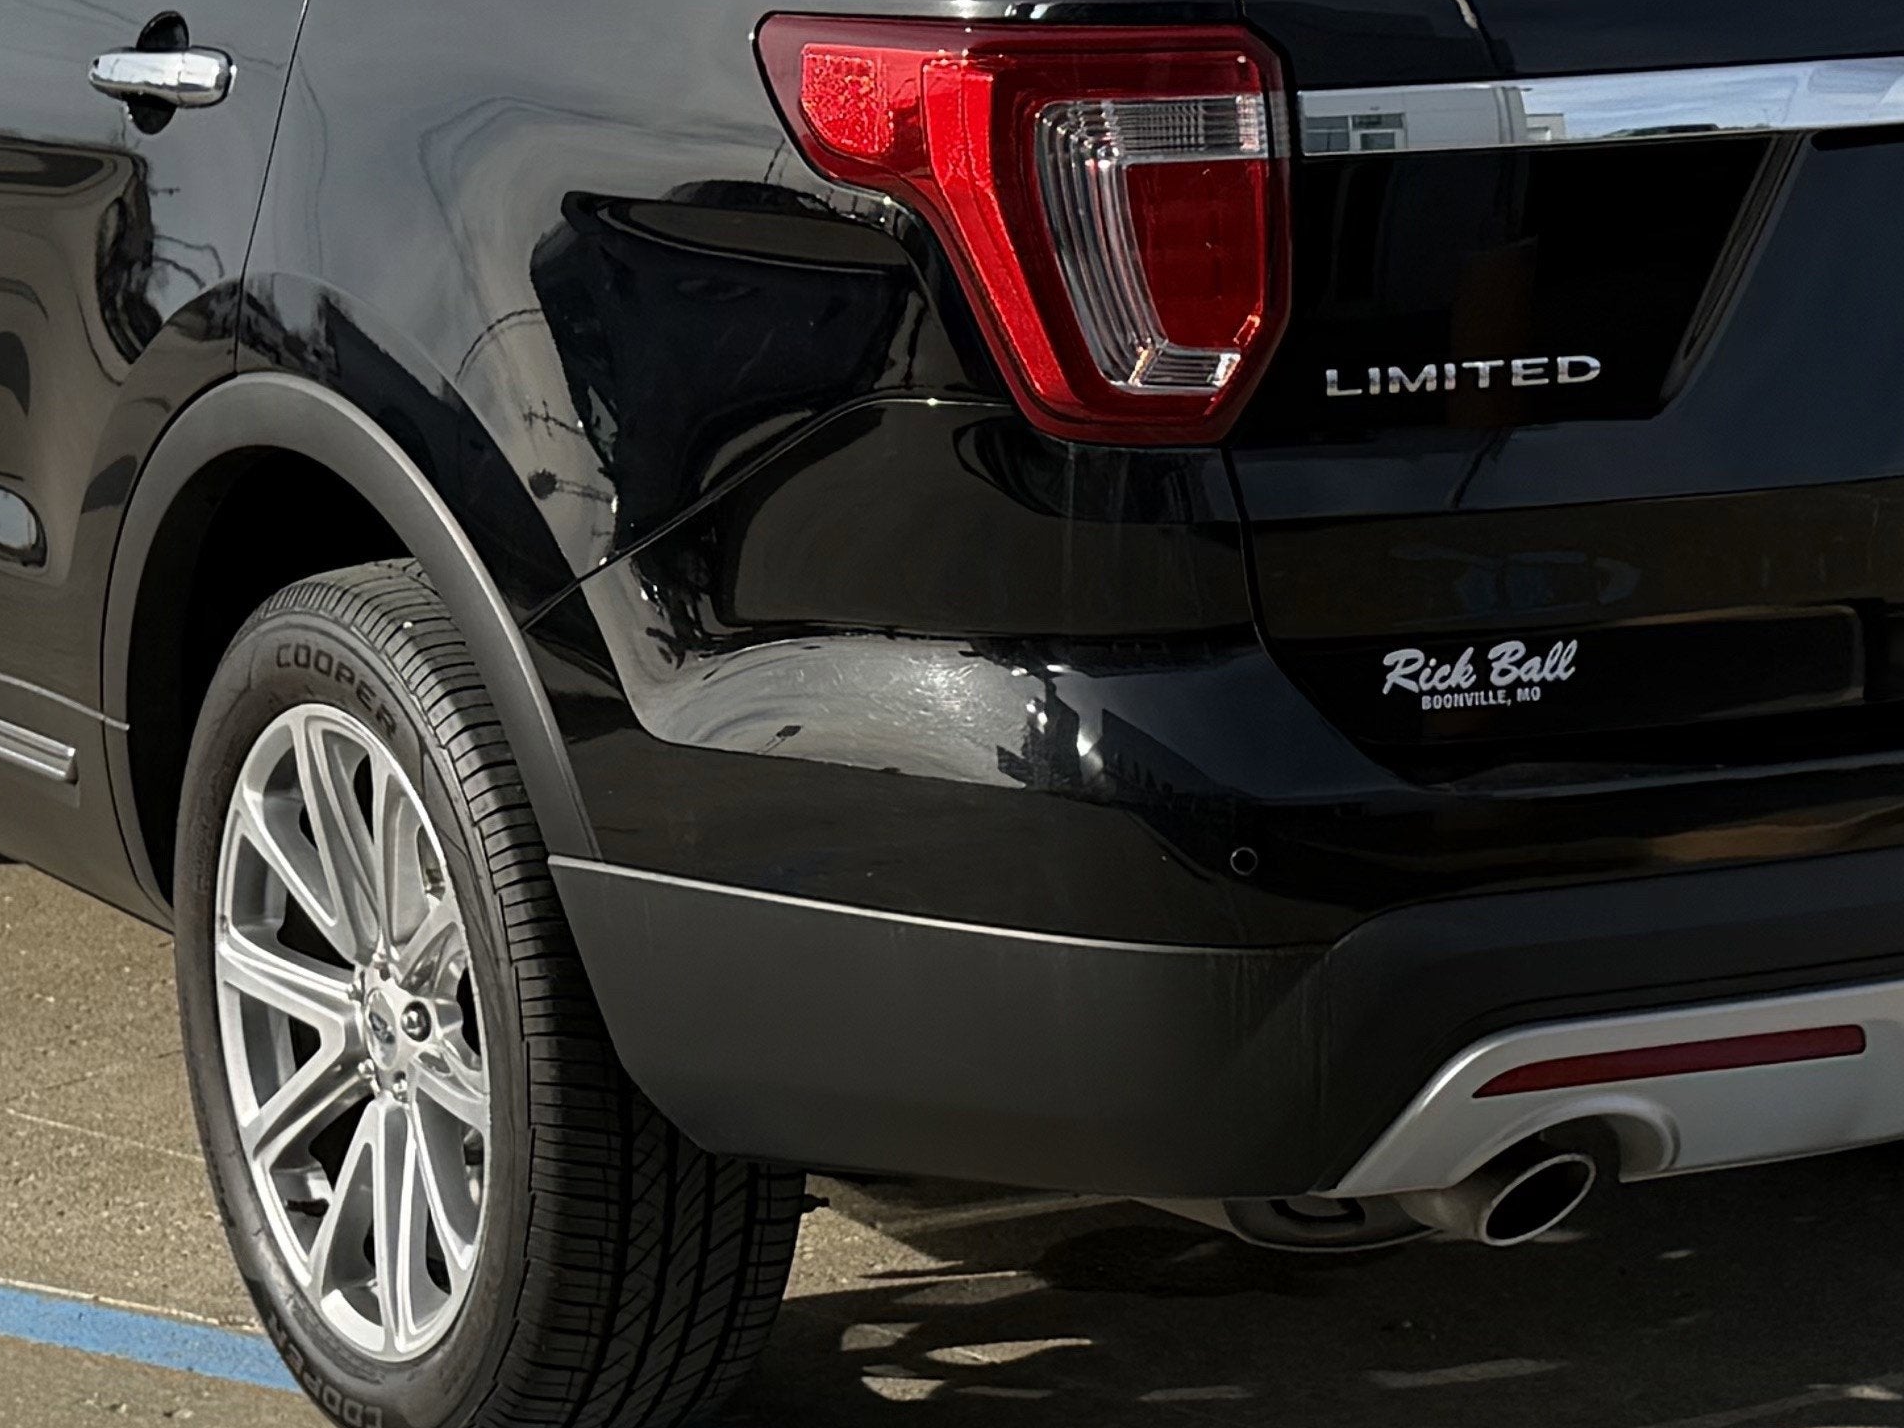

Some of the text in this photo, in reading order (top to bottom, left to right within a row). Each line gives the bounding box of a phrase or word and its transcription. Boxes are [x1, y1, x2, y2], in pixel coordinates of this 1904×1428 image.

[1325, 355, 1602, 397] LIMITED
[275, 642, 397, 740] COOPER
[1382, 639, 1578, 695] Rick Ball
[1421, 685, 1542, 711] BOONVILLE, MO
